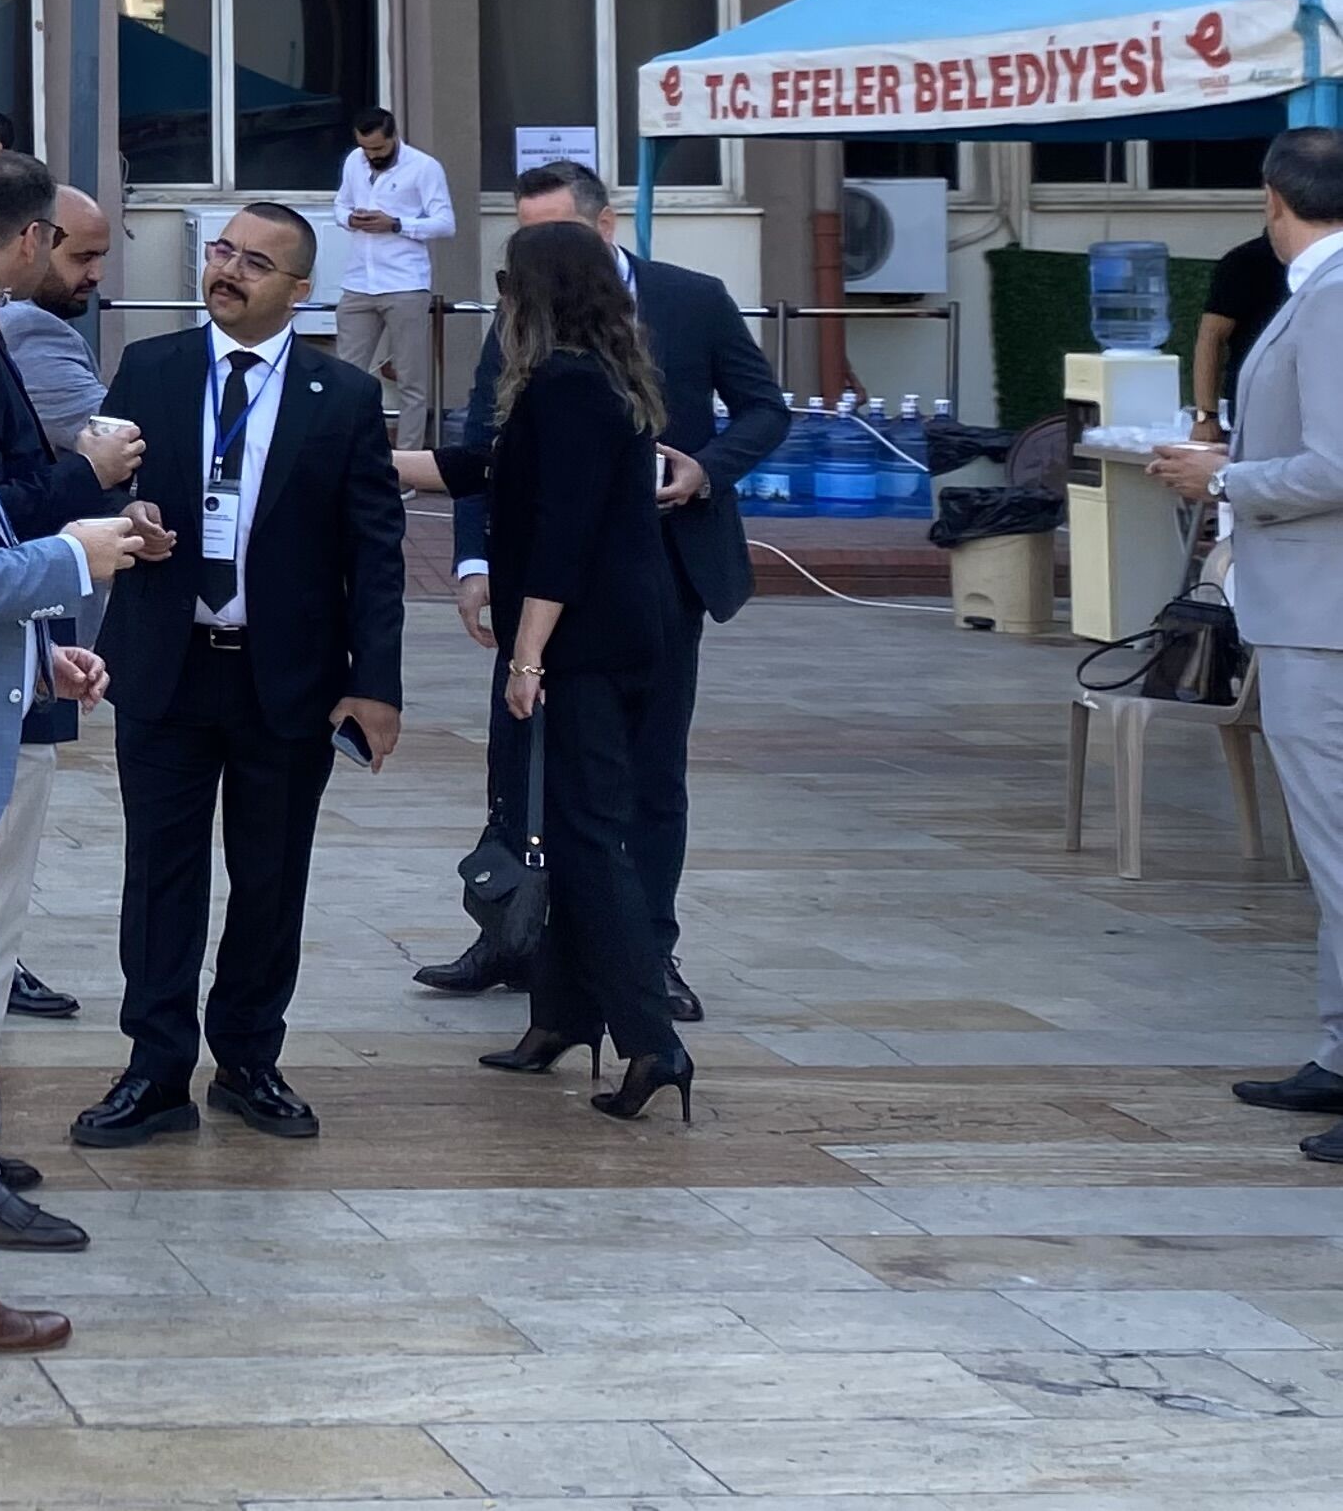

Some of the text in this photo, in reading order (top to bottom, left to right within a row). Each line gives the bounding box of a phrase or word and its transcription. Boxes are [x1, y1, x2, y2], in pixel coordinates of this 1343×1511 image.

[705, 72, 759, 121] T.C.
[770, 64, 901, 119] EFELER
[913, 20, 1165, 114] BELEDİYESİ
